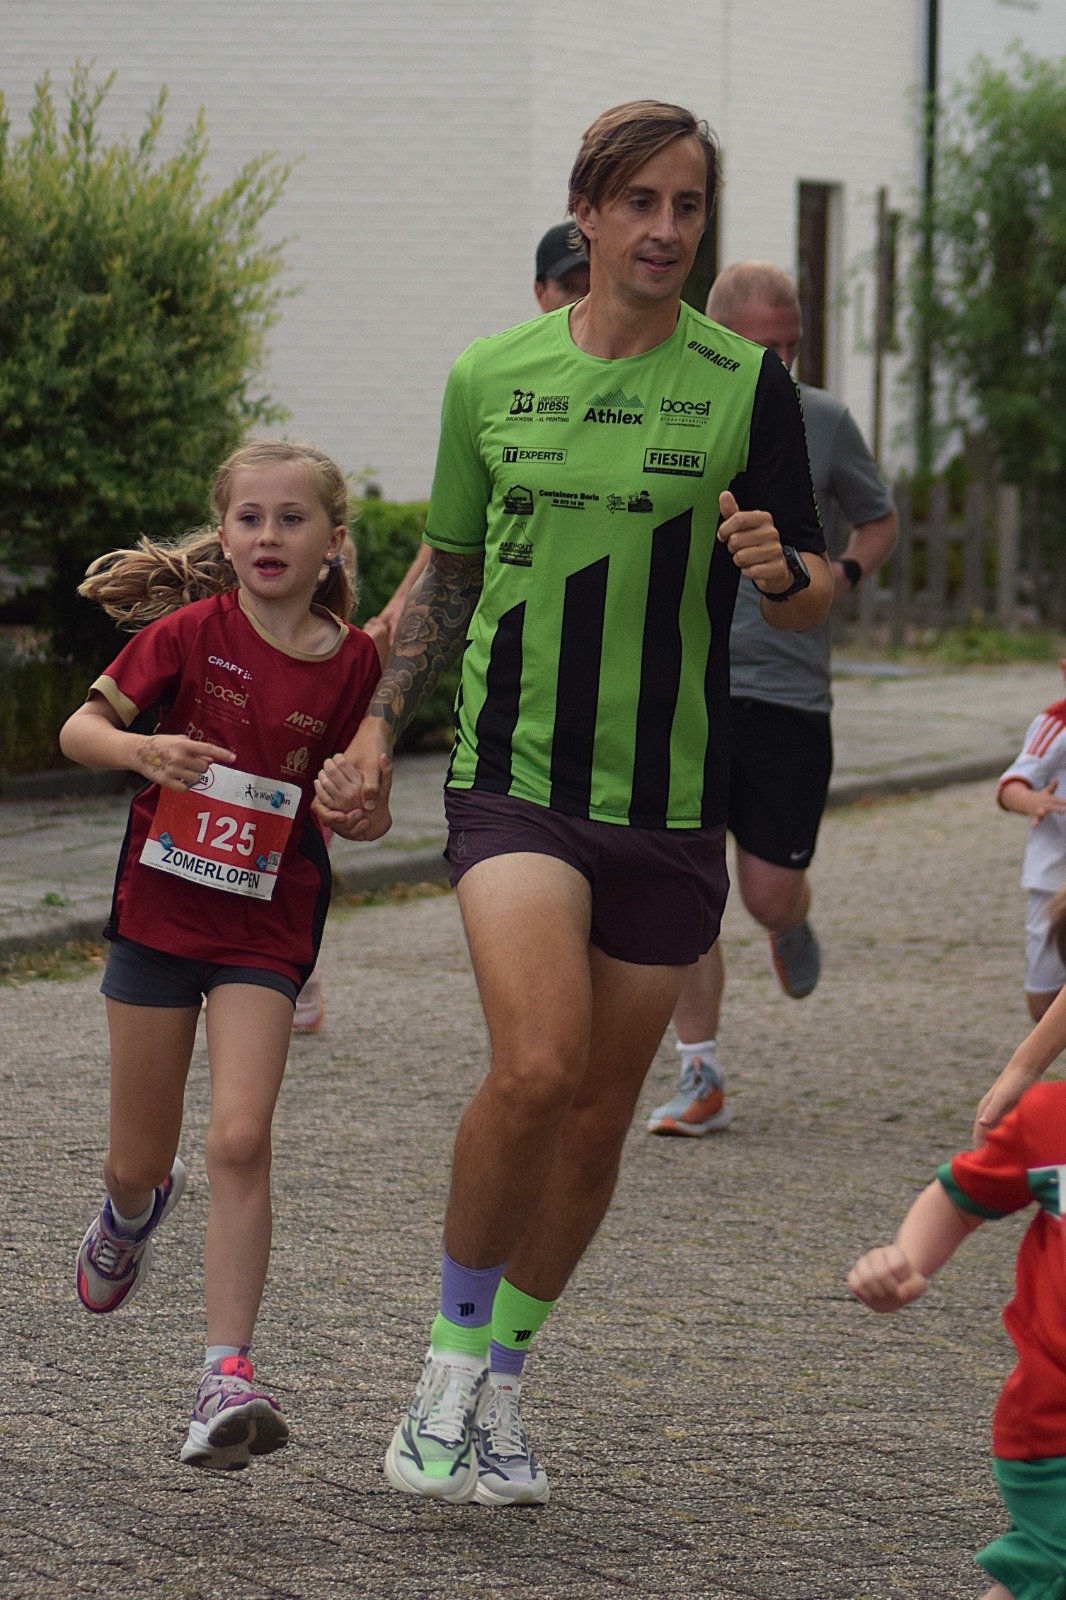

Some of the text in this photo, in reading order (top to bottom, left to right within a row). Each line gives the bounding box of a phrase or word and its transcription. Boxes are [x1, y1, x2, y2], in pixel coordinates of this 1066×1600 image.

[687, 340, 741, 373] BIORACER
[536, 401, 569, 413] press
[583, 408, 643, 425] Athlex
[519, 450, 564, 461] EXPERTS
[649, 452, 701, 468] FIESIEK
[539, 489, 600, 501] Containers Boris
[208, 655, 244, 675] CRAFT
[196, 811, 257, 857] 125
[161, 848, 261, 890] ZOMERLOPEN
